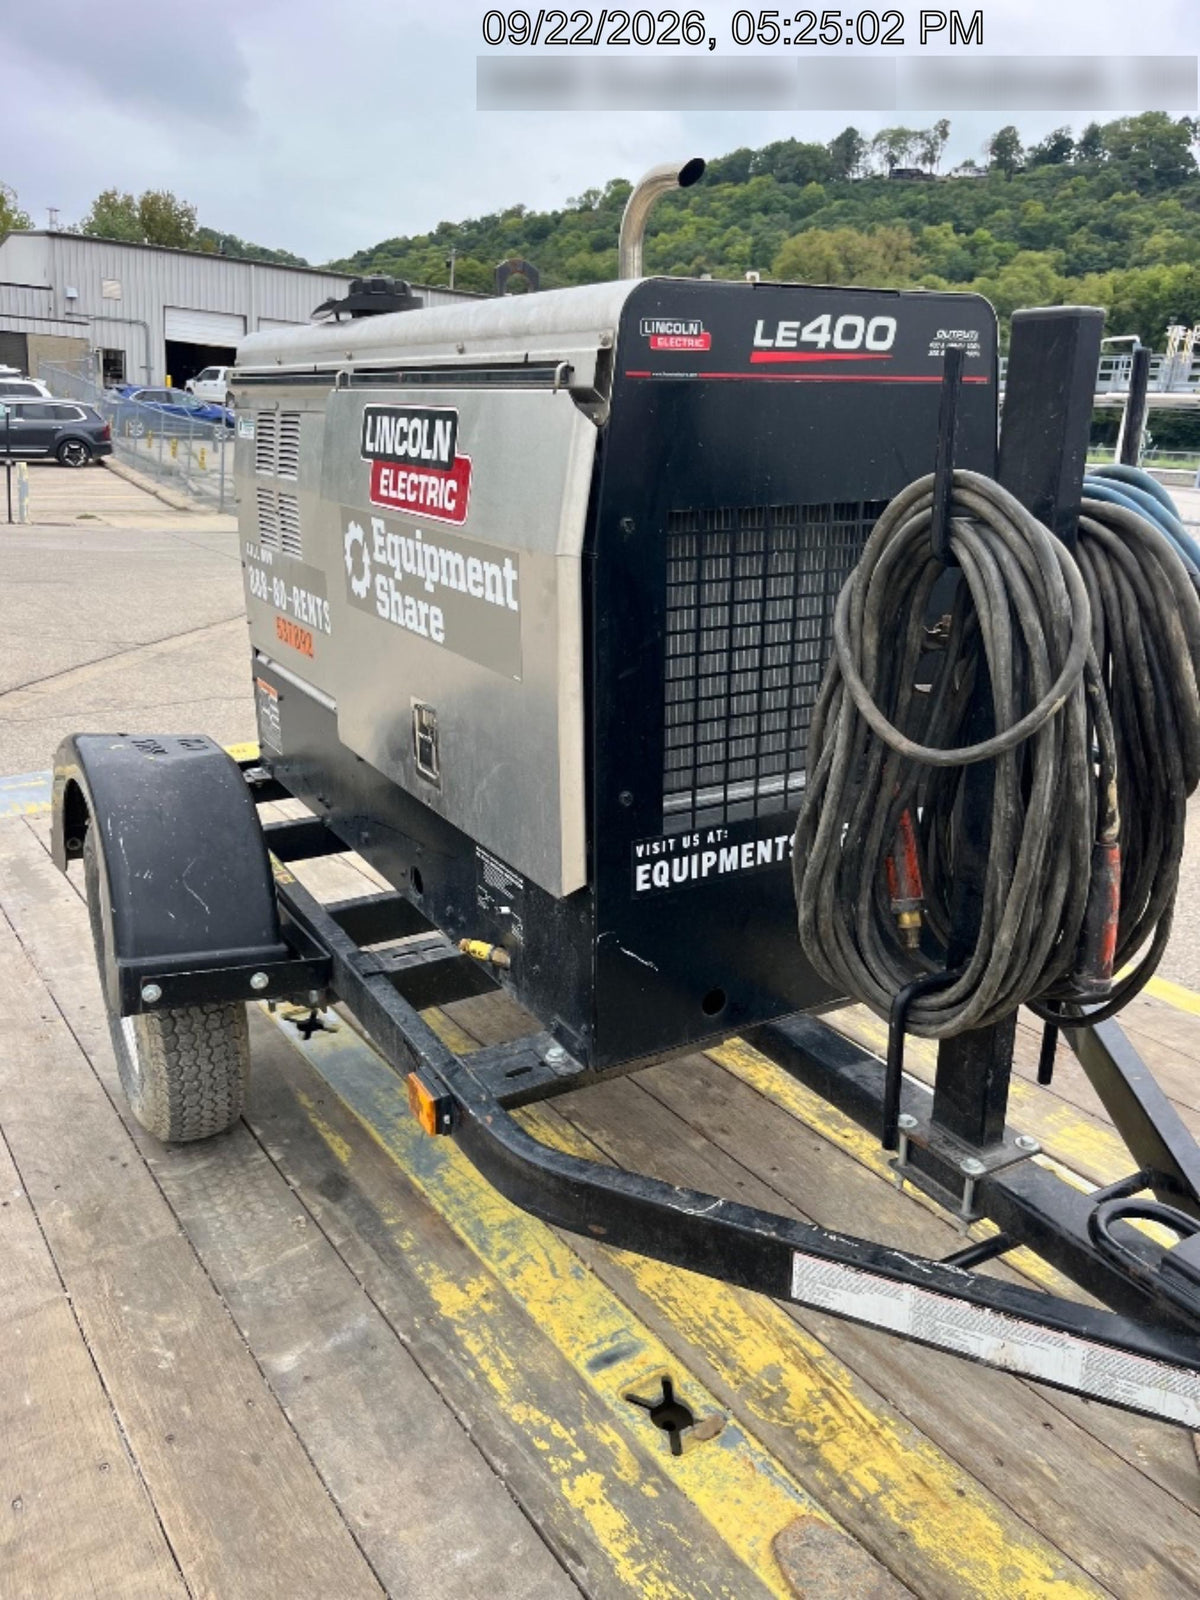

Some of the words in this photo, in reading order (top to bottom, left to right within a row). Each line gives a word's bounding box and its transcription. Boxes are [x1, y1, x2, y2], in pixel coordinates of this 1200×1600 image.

[644, 321, 699, 335] LINCOLN
[657, 337, 705, 348] ELECTRIC
[753, 314, 897, 351] LE400
[365, 415, 452, 463] LINCOLN
[379, 468, 458, 511] ELECTRIC
[371, 516, 519, 612] Equipment
[374, 572, 446, 644] Share
[635, 839, 675, 858] VISIT
[682, 833, 700, 849] US
[707, 829, 729, 845] AT:
